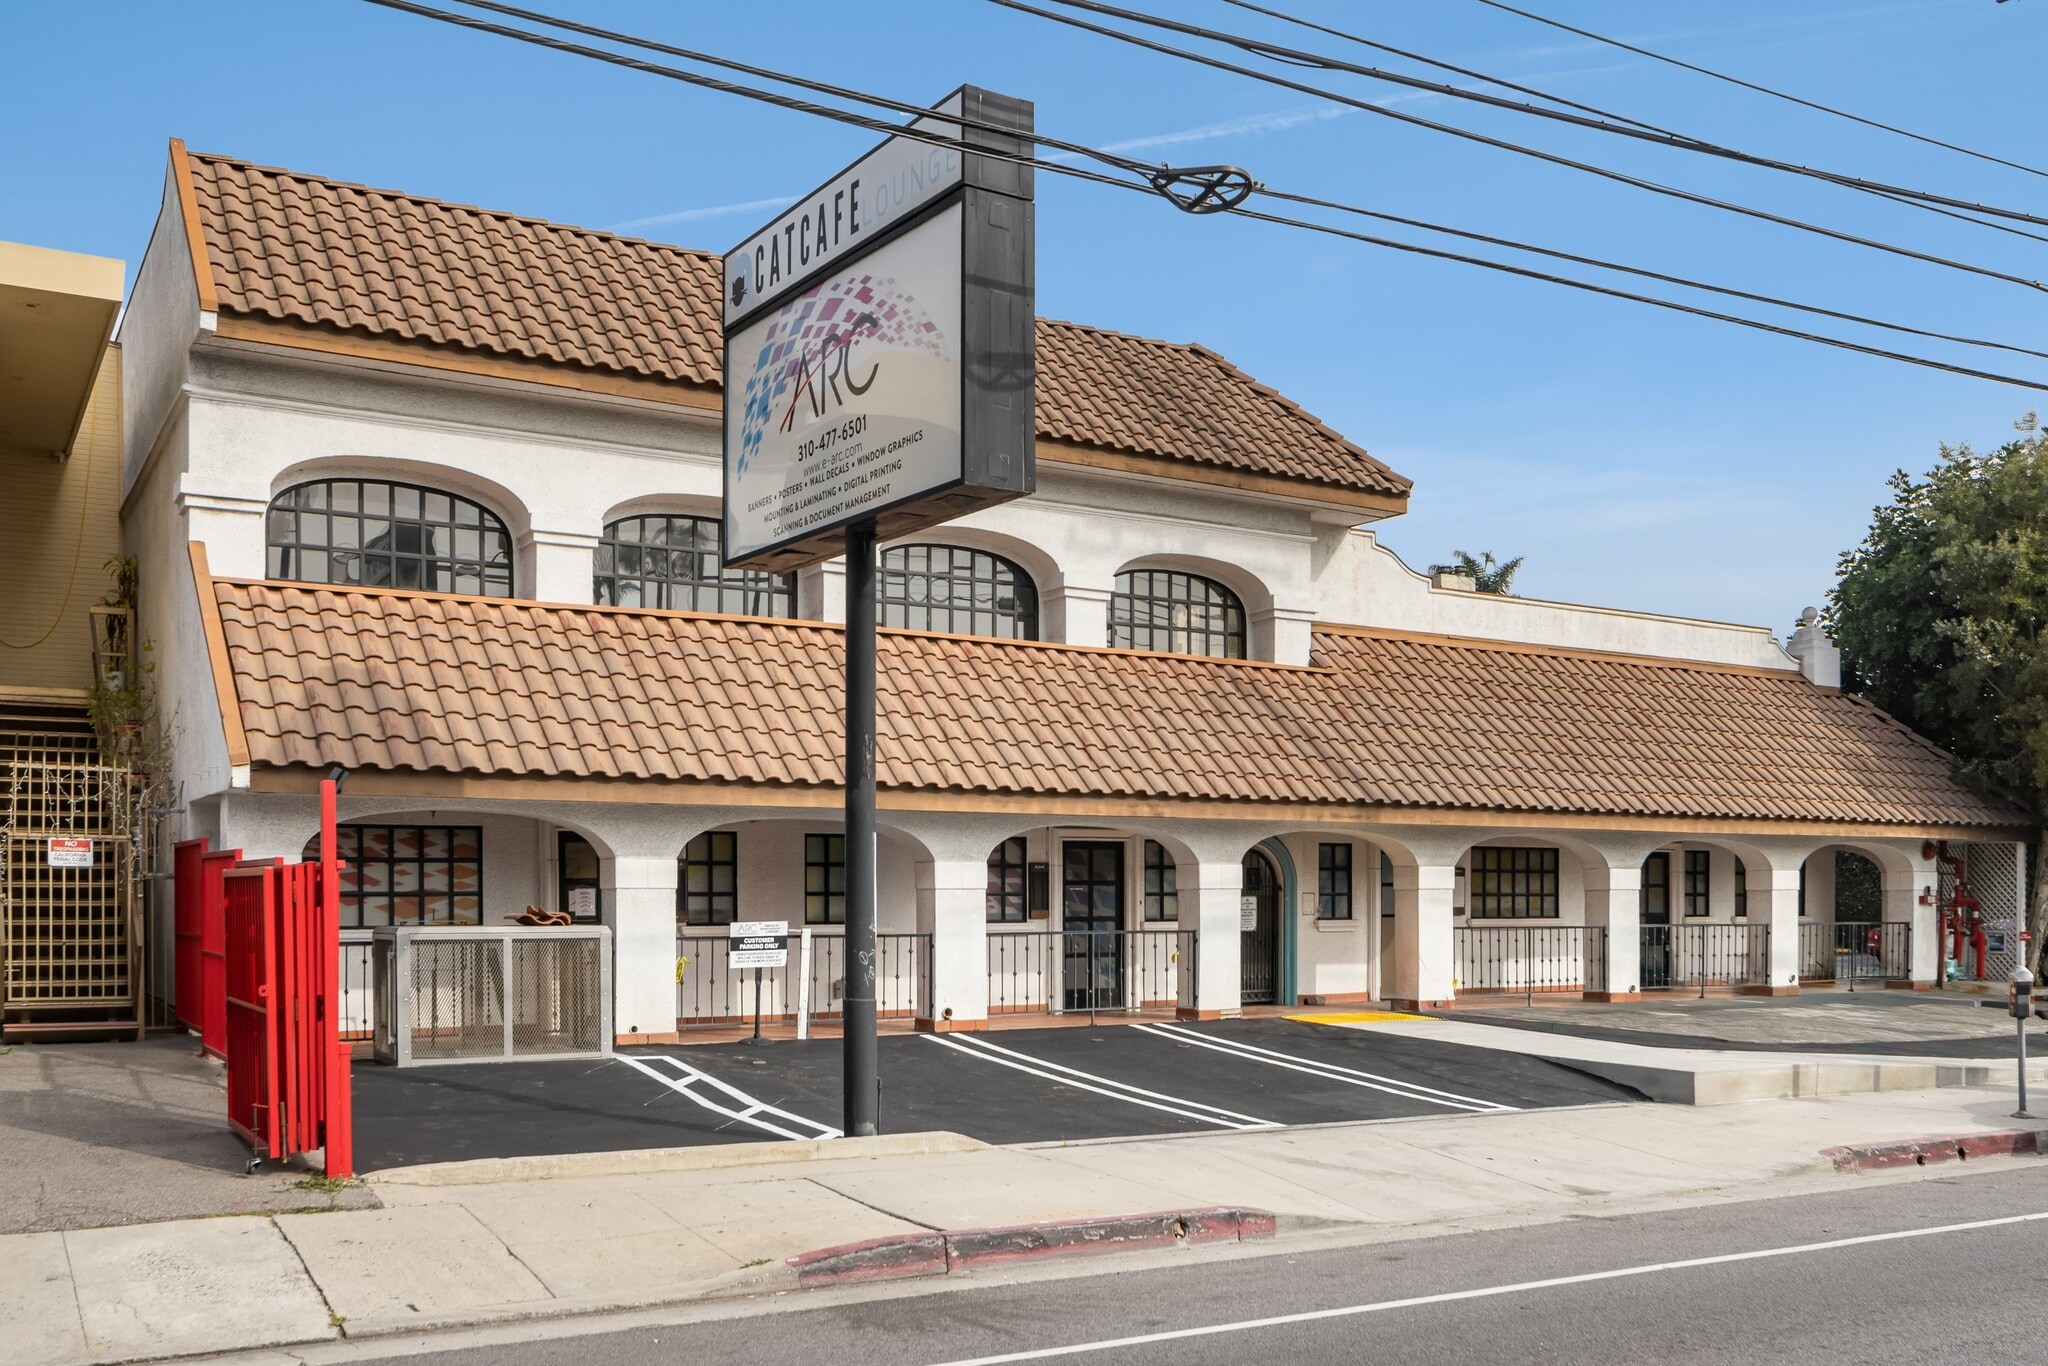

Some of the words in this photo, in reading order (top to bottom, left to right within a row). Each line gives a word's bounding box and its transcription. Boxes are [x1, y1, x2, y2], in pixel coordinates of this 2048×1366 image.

[755, 178, 860, 294] CATCAFE
[786, 313, 880, 433] ARC
[797, 413, 867, 462] 310-477-6501
[803, 442, 863, 477] www.e-arc.com
[748, 494, 773, 513] BANNERS
[778, 482, 803, 500] POSTERS
[809, 473, 826, 487] WALL
[826, 462, 850, 480] DECALS
[856, 445, 887, 467] WINDOW
[887, 429, 924, 454] GRAPHICS
[763, 503, 794, 523] MOUNTING
[794, 502, 799, 512] &
[800, 486, 837, 509] LAMINATING
[843, 473, 869, 492] DIGITAL
[869, 459, 902, 481] PRINTING
[773, 518, 803, 538] SCANNING
[804, 516, 809, 526] &
[809, 502, 844, 524] DOCUMENT
[845, 483, 891, 511] MANAGEMENT
[737, 924, 757, 933] ARC
